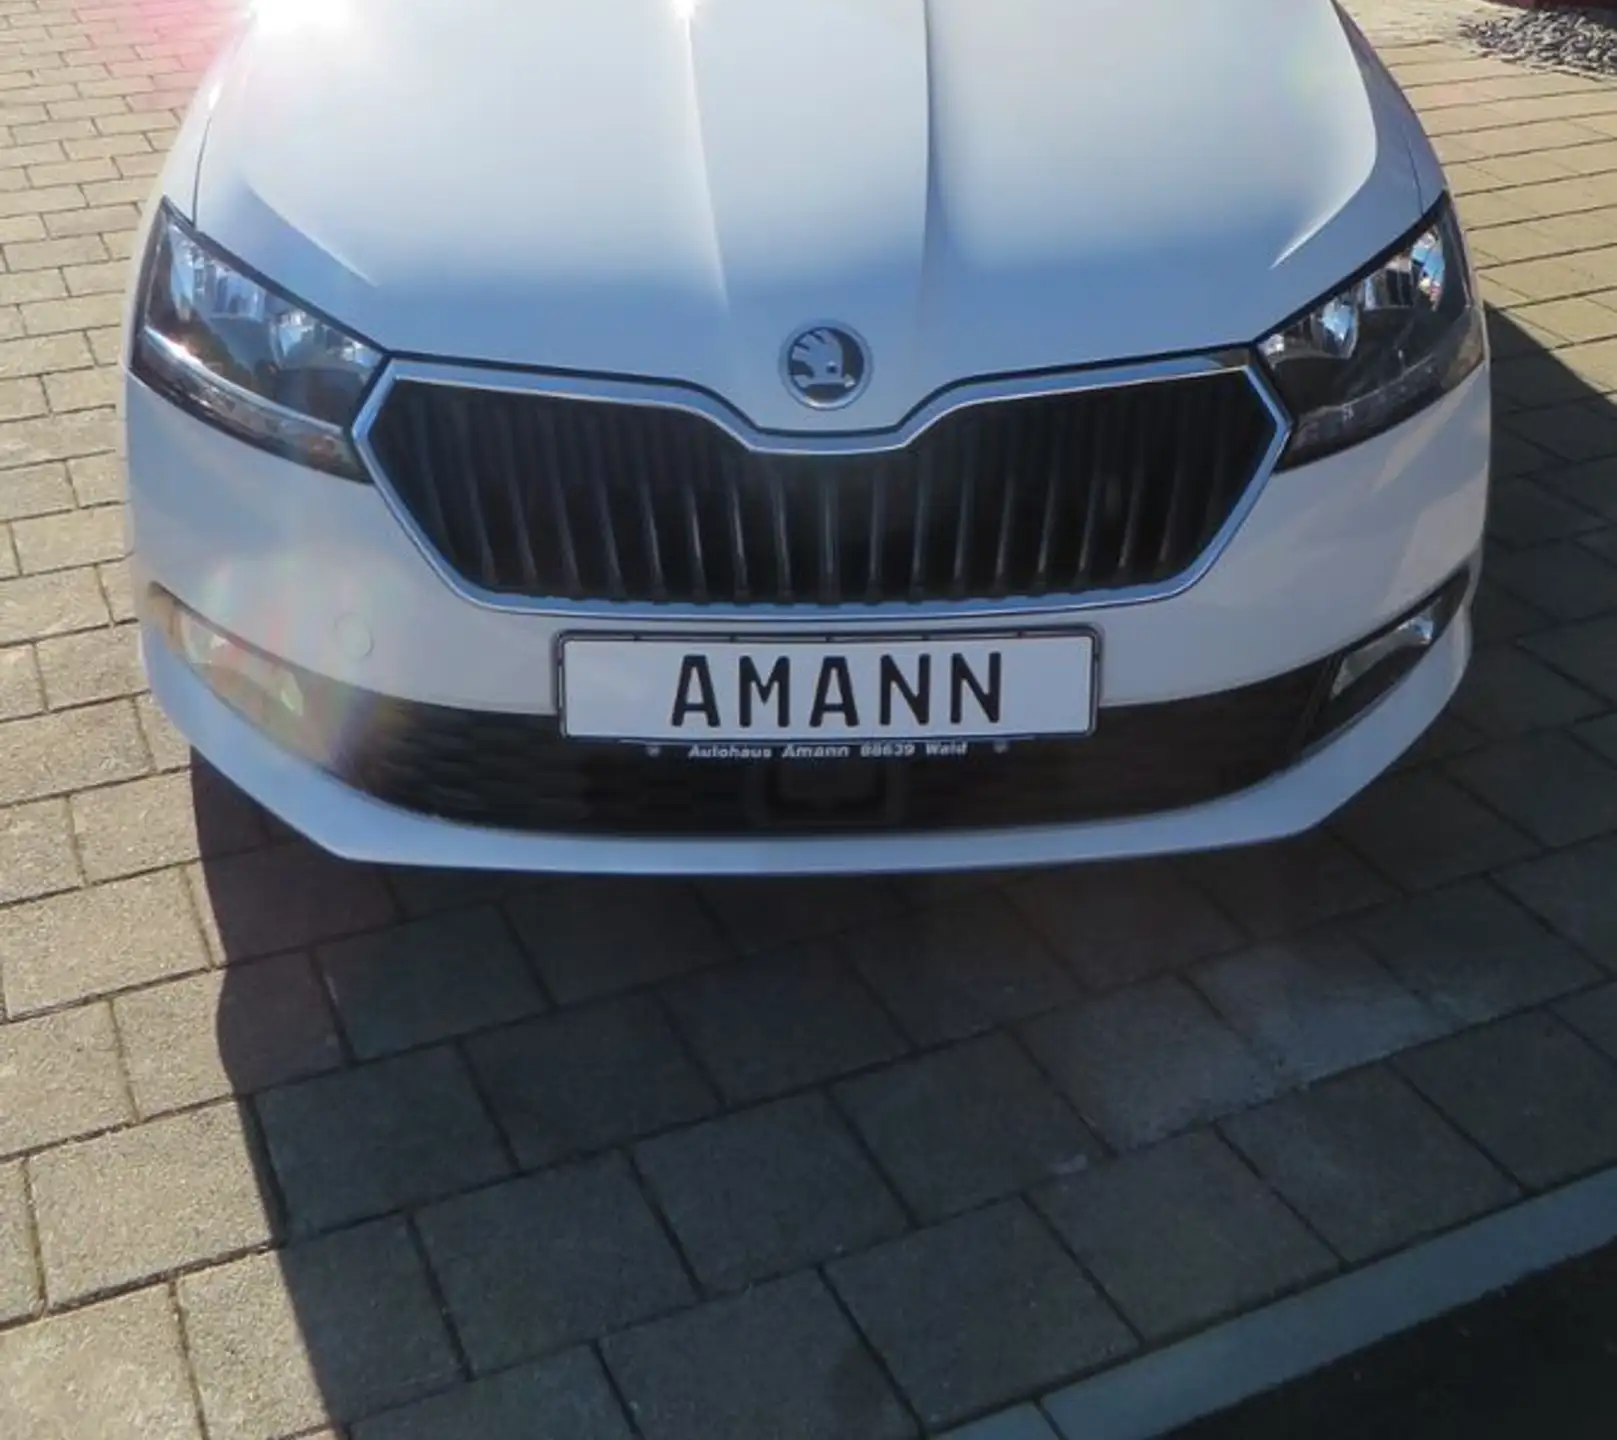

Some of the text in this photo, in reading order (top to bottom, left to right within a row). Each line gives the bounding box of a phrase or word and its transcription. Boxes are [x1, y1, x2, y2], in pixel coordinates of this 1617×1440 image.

[671, 652, 1002, 728] AMANN
[688, 743, 772, 759] Autohaus
[781, 743, 850, 758] Amann
[925, 741, 968, 756] Wald
